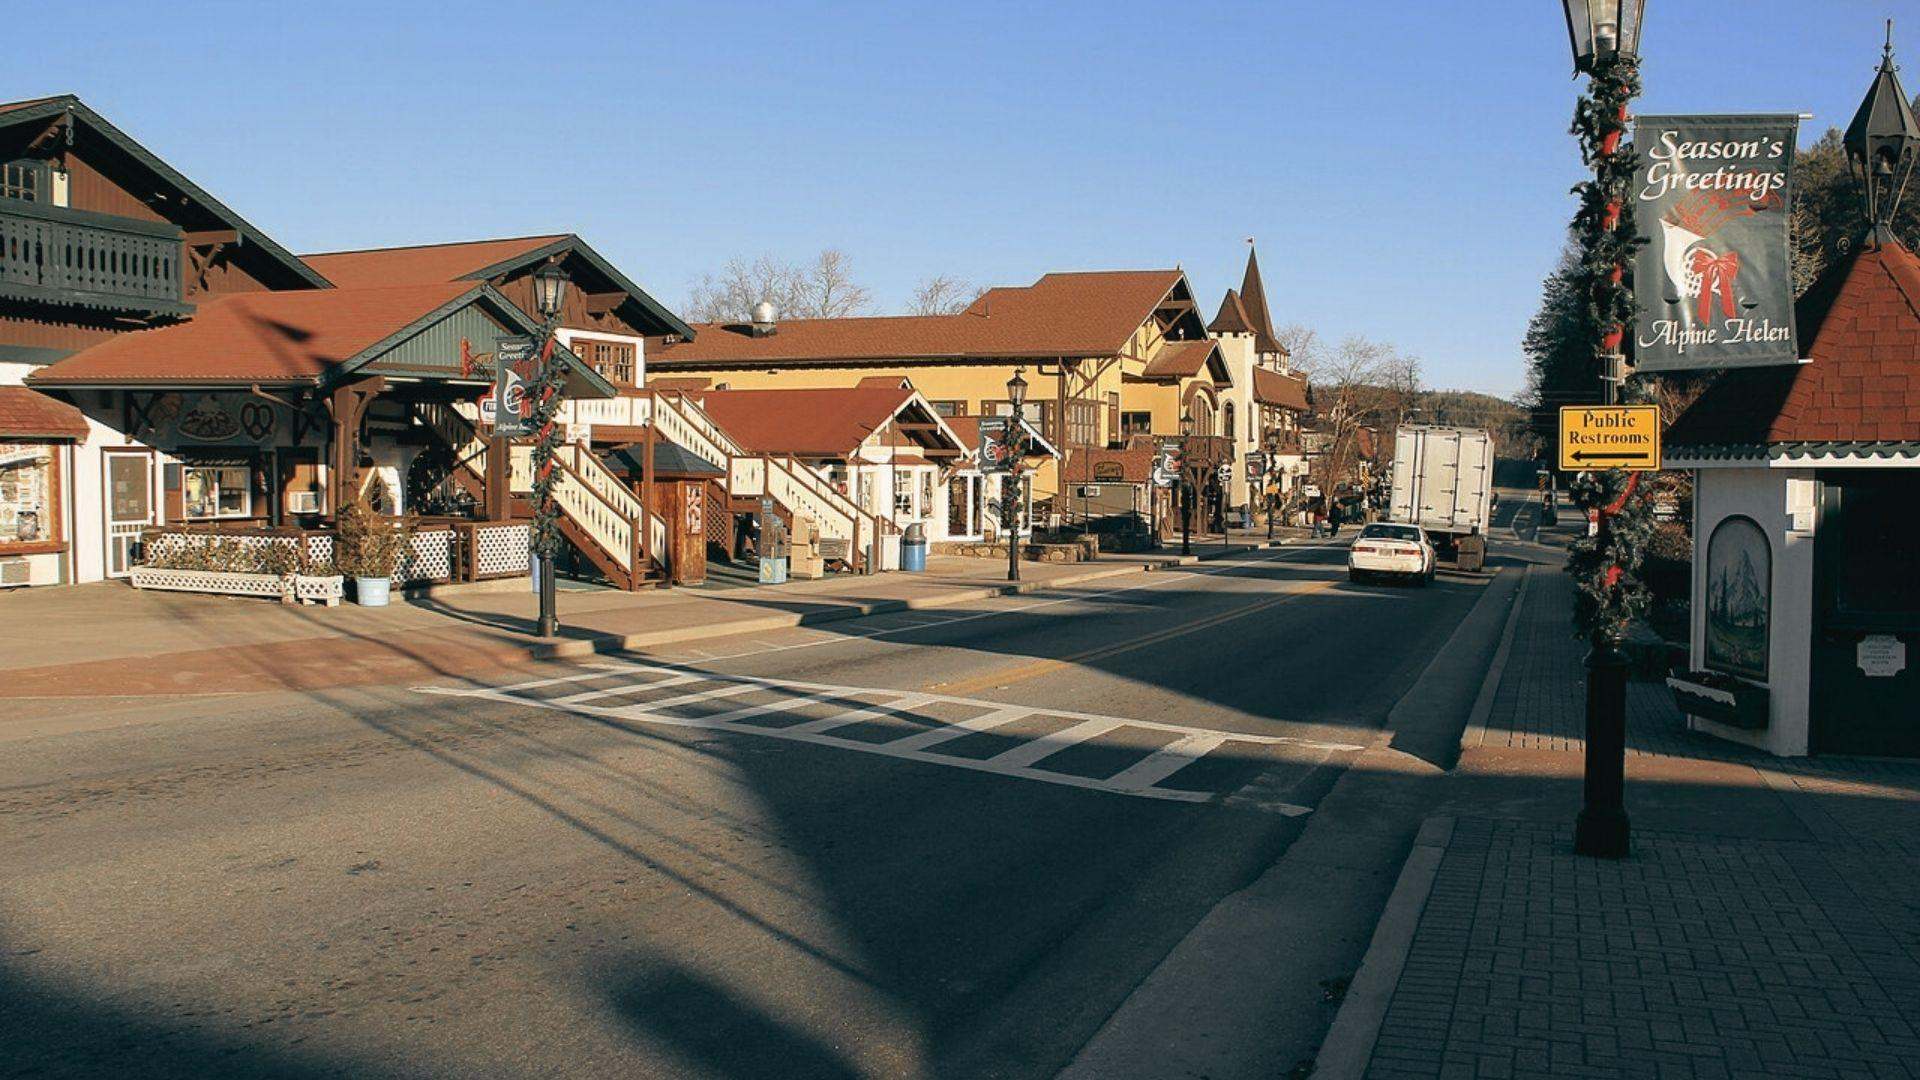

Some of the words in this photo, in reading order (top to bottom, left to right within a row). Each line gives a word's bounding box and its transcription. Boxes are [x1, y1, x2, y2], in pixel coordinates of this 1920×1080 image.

[1649, 130, 1784, 160] Season's
[1638, 162, 1786, 201] Greetings
[1638, 319, 1718, 354] Alpine
[1721, 318, 1791, 344] Helen
[1583, 412, 1636, 428] Public
[1569, 431, 1650, 445] Restrooms
